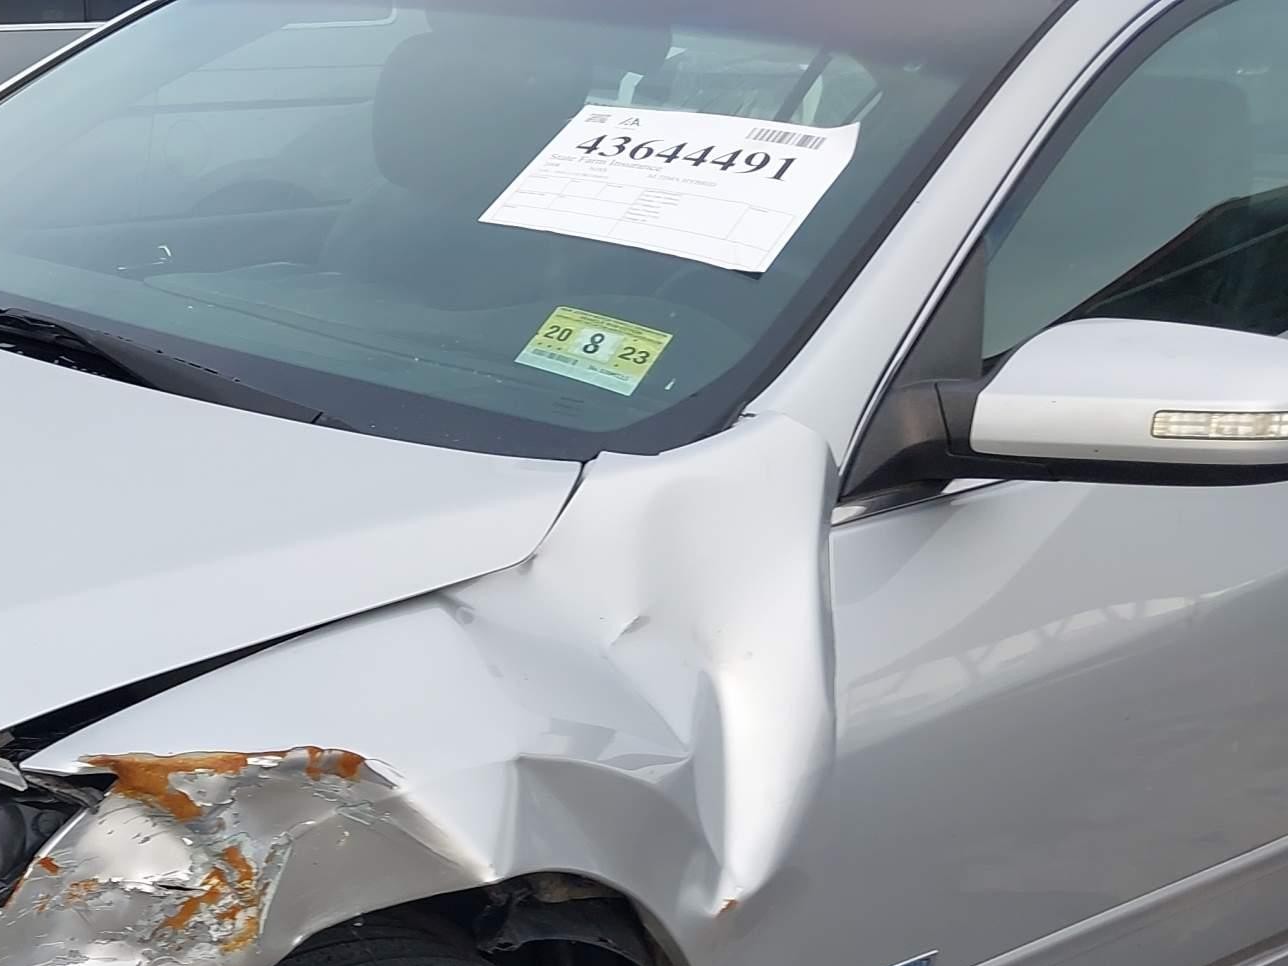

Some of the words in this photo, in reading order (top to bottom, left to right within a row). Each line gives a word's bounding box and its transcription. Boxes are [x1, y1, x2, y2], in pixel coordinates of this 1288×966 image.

[575, 134, 798, 182] 43644491
[543, 325, 573, 342] 20
[582, 332, 605, 354] 8
[618, 346, 650, 365] 23
